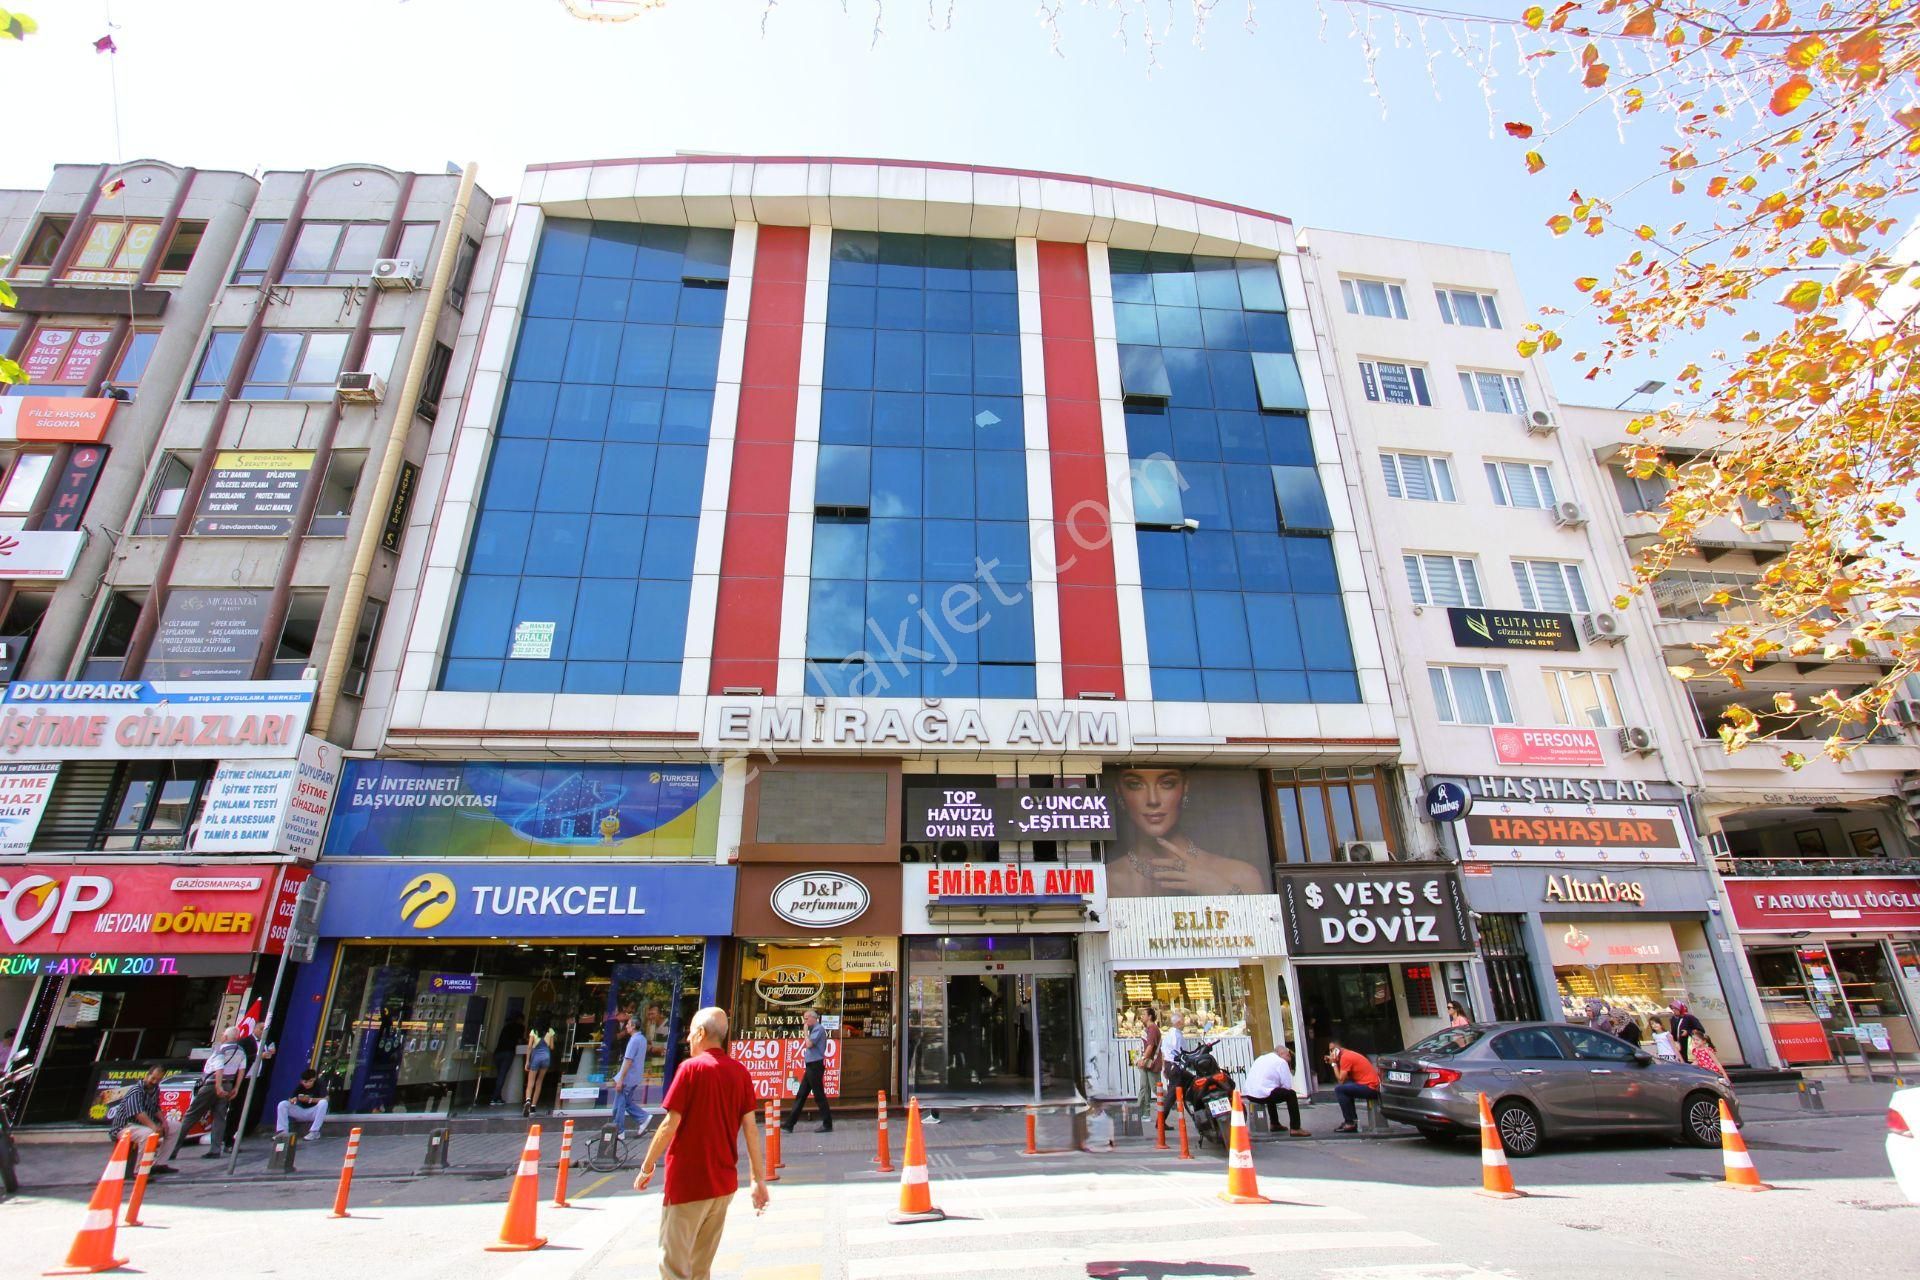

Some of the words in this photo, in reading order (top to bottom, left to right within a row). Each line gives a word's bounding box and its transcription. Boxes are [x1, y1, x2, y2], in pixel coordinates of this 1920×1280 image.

[35, 346, 62, 355] FİLİZ
[29, 409, 53, 417] FİLİZ
[55, 410, 97, 420] HAŞHAŞ
[36, 419, 80, 428] SİGORTA
[266, 471, 297, 479] EPİLASYON
[215, 480, 240, 488] BÖLGESEL
[209, 502, 221, 511] İPEK
[1494, 616, 1529, 628] ELITA
[1533, 618, 1560, 629] LIFE
[1497, 628, 1531, 636] GÜZELLİK
[171, 645, 201, 653] BÖLGESEL
[12, 684, 143, 700] DUYUPARK
[188, 694, 209, 702] SATIŞ
[718, 697, 990, 746] EMİRAĞA
[1007, 709, 1120, 746] AVM
[0, 707, 108, 754] İŞİTME
[115, 707, 296, 747] CİHAZLARI
[1523, 732, 1595, 748] PERSONA
[17, 763, 60, 772] EMEKLİLERE
[216, 768, 245, 781] İŞİTME
[247, 768, 293, 780] CİHAZLARI
[299, 763, 336, 785] DUYUPARK
[356, 778, 377, 790] EV
[381, 775, 461, 791] İNTERNETİ
[662, 774, 699, 782] TURKCELL
[222, 783, 250, 796] İŞİTME
[253, 783, 278, 794] TESTİ
[297, 779, 328, 801] İŞİTME
[1479, 775, 1652, 806] HAŞHAŞLAR
[213, 799, 251, 811] ÇINLAMA
[253, 798, 278, 808] TESTİ
[352, 794, 426, 810] BAŞVURU
[429, 794, 498, 807] NOKTASI
[943, 791, 976, 804] TOP
[1788, 794, 1838, 803] Restaurant
[291, 796, 327, 816] CİHAZLARI
[1430, 799, 1460, 816] Altınbaş
[206, 813, 219, 825] PİL
[221, 815, 228, 824] &
[229, 815, 276, 824] AKSESUAR
[292, 814, 309, 827] SATIŞ
[310, 820, 318, 828] VE
[928, 809, 992, 821] HAVUZU
[204, 829, 230, 839] TAMİR
[232, 830, 239, 839] &
[241, 830, 269, 839] BAKIM
[285, 823, 320, 838] UYGULAMA
[925, 825, 967, 837] OYUN
[970, 822, 995, 837] EVİ
[1489, 818, 1658, 845] HAŞHAŞLAR
[287, 833, 314, 846] MERKEZİ
[290, 844, 301, 854] kat
[176, 878, 252, 889] GAZİOSMANPAŞA
[928, 862, 1034, 895] EMİRAĞA
[1045, 869, 1094, 894] AVM
[803, 880, 844, 896] D&P
[1305, 882, 1324, 909] $
[1334, 881, 1415, 905] VEYS
[1423, 880, 1443, 905] €
[1546, 873, 1646, 907] Altınbaş
[472, 886, 646, 915] TURKCELL
[790, 898, 858, 913] perfumum
[94, 913, 152, 933] MEYDAN
[152, 906, 254, 934] DÖNER
[1173, 906, 1230, 931] ELİF
[1320, 908, 1440, 944] DÖVİZ
[1149, 935, 1256, 950] KUYUMCULUK
[122, 957, 154, 974] 200
[157, 957, 178, 974] TL
[778, 972, 806, 983] D&P
[766, 985, 814, 997] perfumum
[755, 1017, 774, 1025] BAY
[776, 1017, 784, 1025] &
[740, 1029, 779, 1039] İTHAL
[783, 1030, 832, 1039] PARM
[737, 1040, 780, 1059] %50
[792, 1039, 837, 1058] %0
